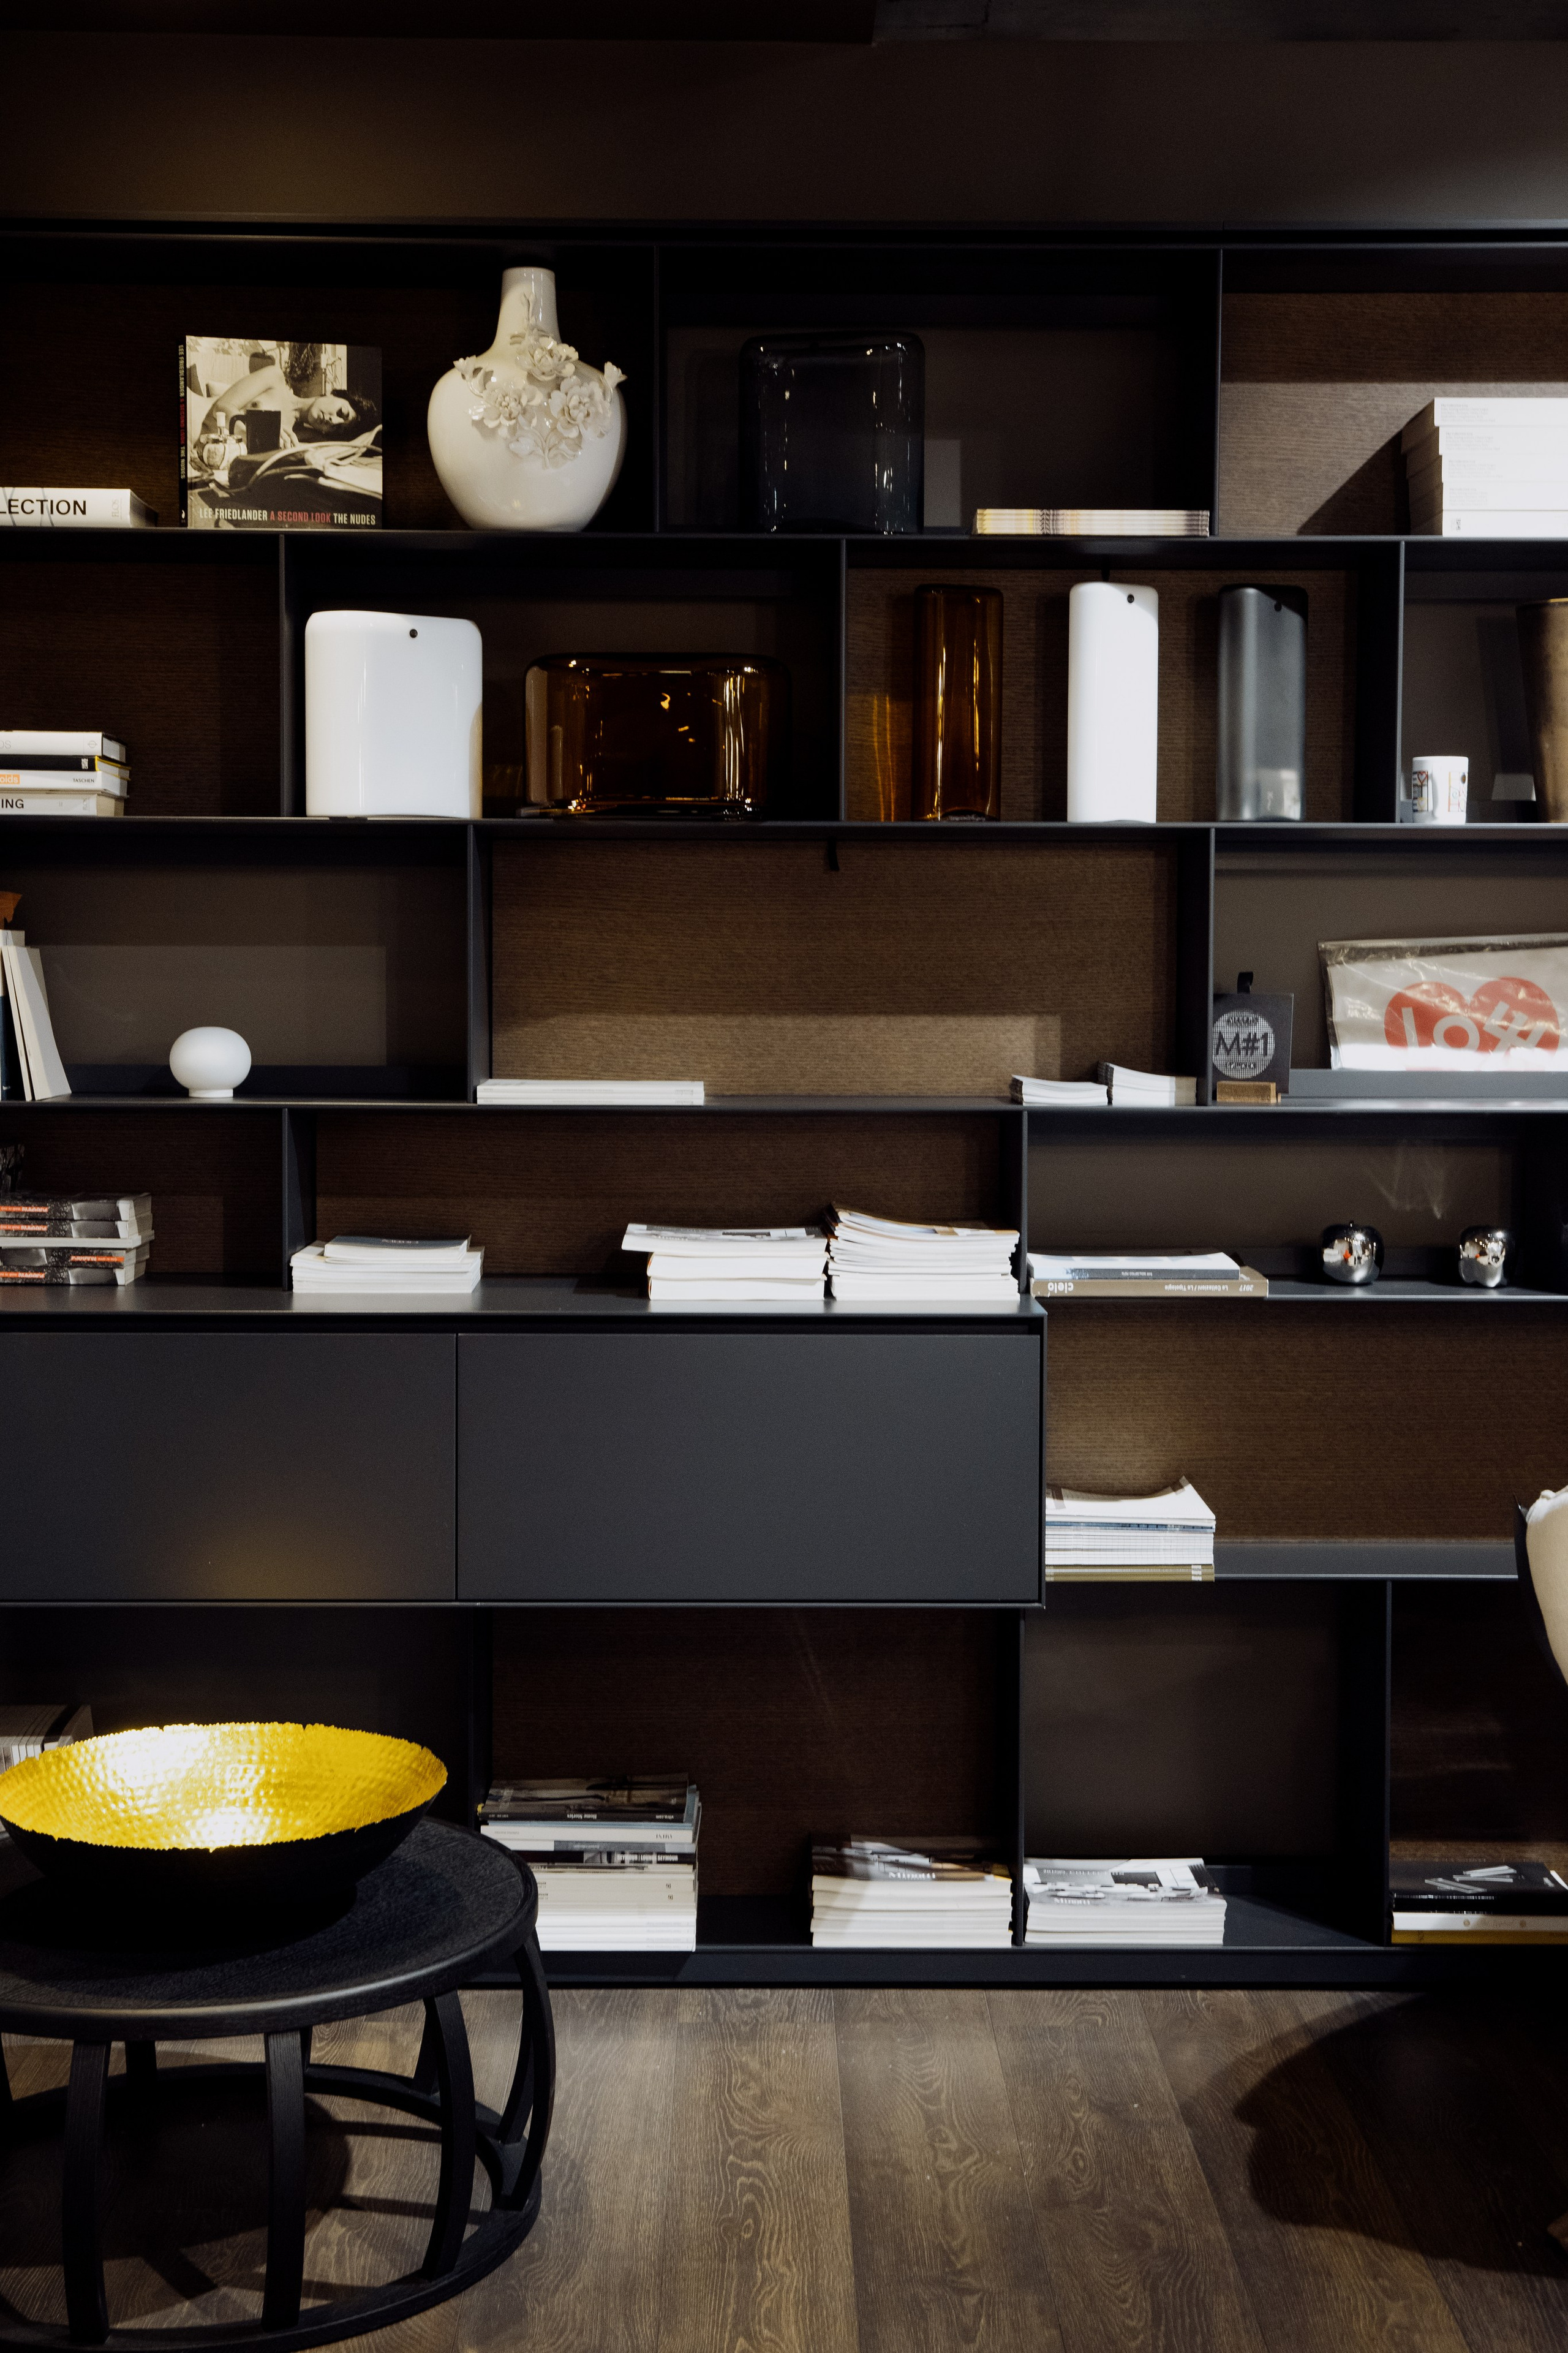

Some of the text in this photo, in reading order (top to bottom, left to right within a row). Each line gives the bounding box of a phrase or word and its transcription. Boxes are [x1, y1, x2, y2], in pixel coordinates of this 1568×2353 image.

[0, 499, 86, 515] ECTION
[199, 508, 375, 526] LEE FRIEDLANDER A SECOND LOOK THE NUDES
[1, 799, 24, 809] ING
[1215, 1030, 1268, 1057] M#1
[1047, 1282, 1074, 1293] cielo
